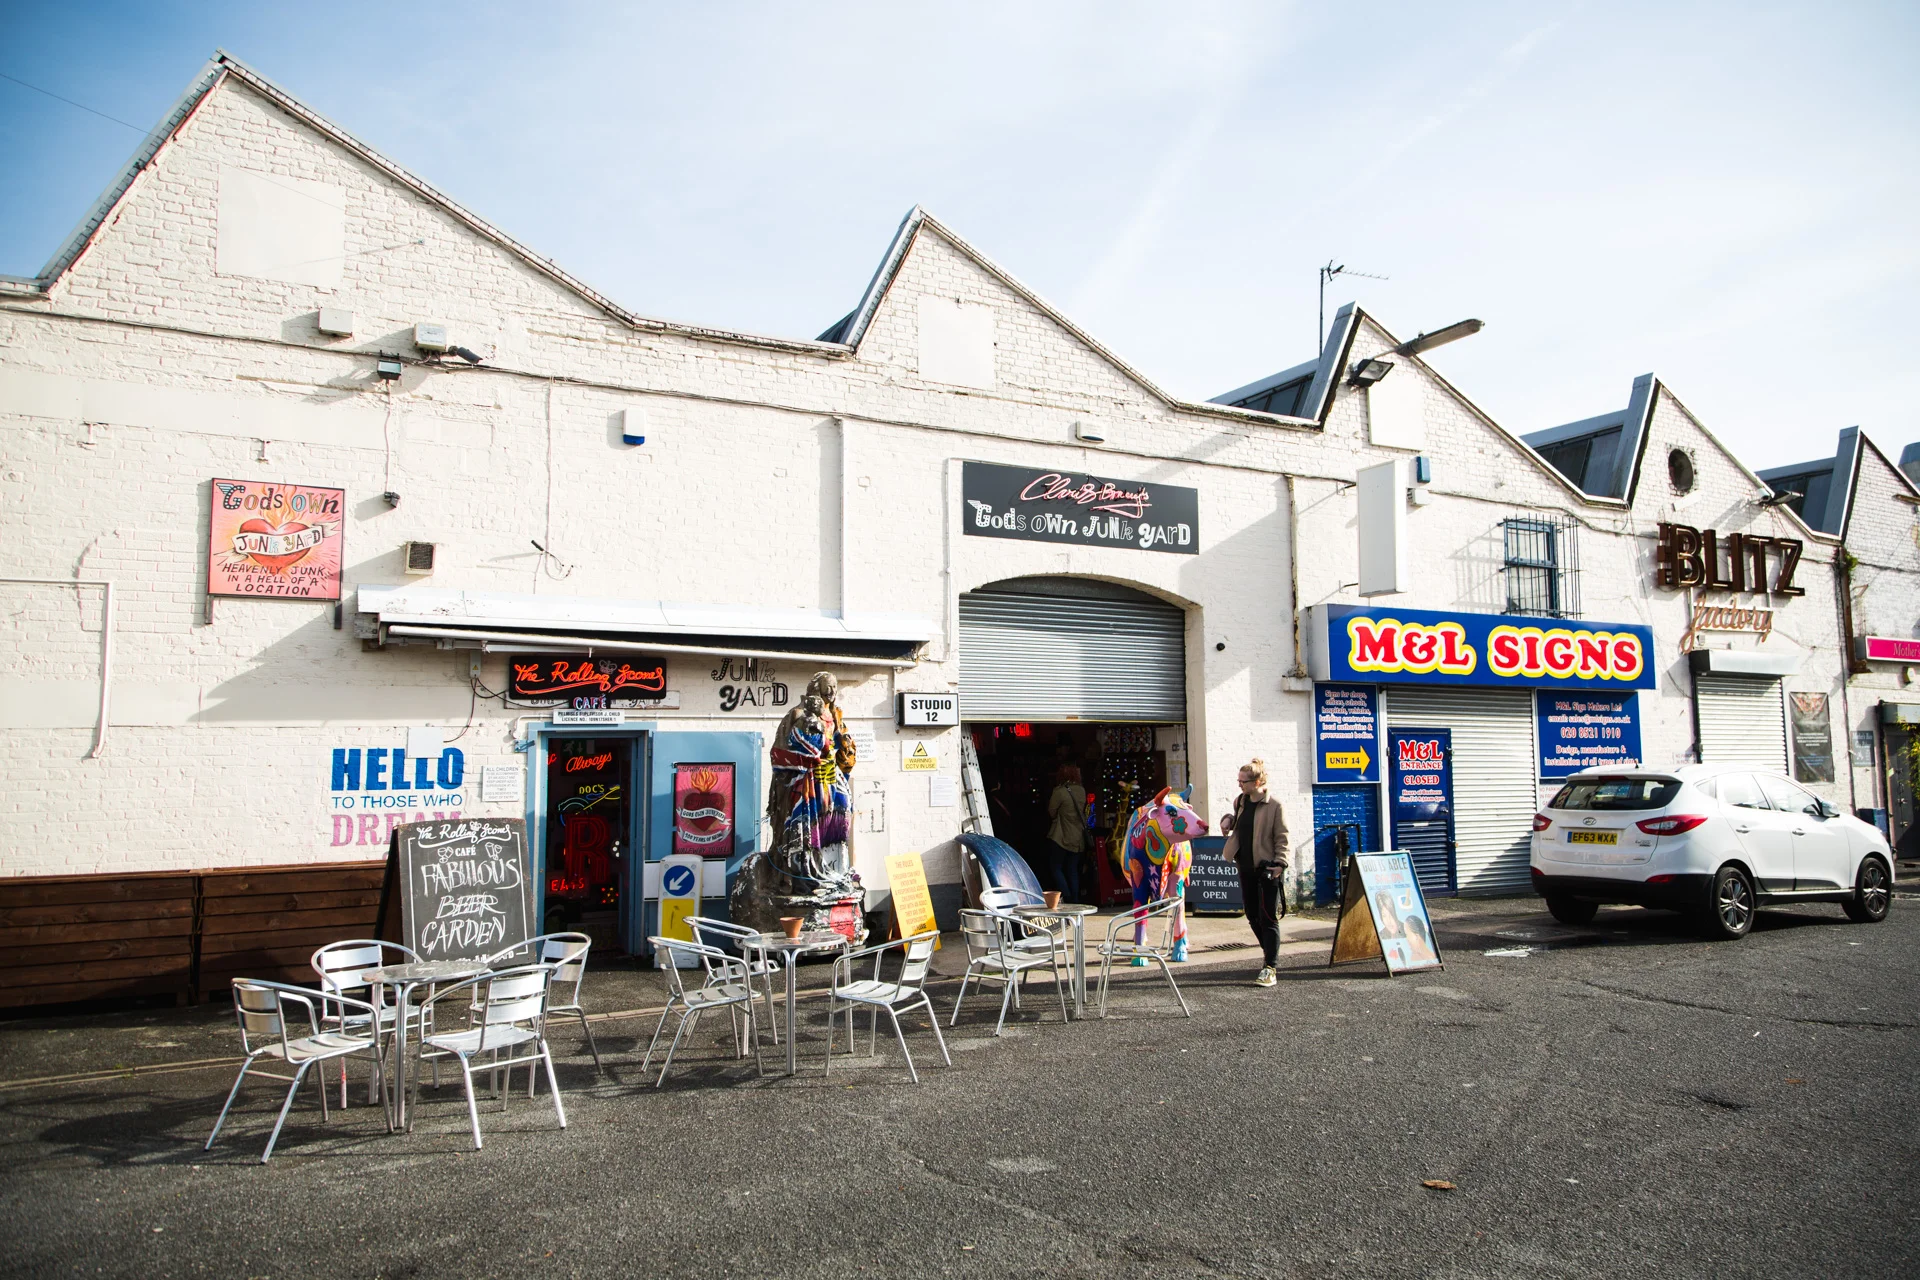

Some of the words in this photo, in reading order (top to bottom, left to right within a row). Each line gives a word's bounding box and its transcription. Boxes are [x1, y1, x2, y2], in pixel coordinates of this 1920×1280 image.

[216, 483, 283, 511] Gods
[967, 499, 1027, 532] Gods
[1657, 522, 1806, 597] BLITZ
[221, 563, 283, 575] HEAVENLY
[290, 566, 326, 577] JUNK
[227, 574, 239, 582] IN
[244, 574, 252, 582] A
[257, 575, 285, 584] HELL
[291, 576, 303, 585] OF
[309, 576, 319, 586] A
[235, 584, 311, 596] LOCATION
[1350, 621, 1474, 670] M&L
[1490, 630, 1641, 676] SIGNS
[573, 694, 608, 710] CAFÉ
[911, 700, 952, 710] STUDIO
[1573, 702, 1586, 713] Sign
[1587, 702, 1610, 711] Makers
[925, 712, 938, 722] 12
[1561, 727, 1577, 738] 020
[1601, 727, 1622, 739] 1910
[1398, 739, 1444, 761] M&L
[566, 751, 613, 772] Always
[1400, 761, 1443, 770] ENTRANCE
[331, 747, 464, 791] HELLO
[1404, 775, 1439, 785] CLOSED
[579, 784, 605, 794] DOC'S
[331, 796, 355, 809] TO
[360, 795, 418, 808] THOSE
[423, 794, 463, 807] WHO
[440, 823, 478, 844] Rolling
[1572, 832, 1595, 842] EF63
[455, 845, 476, 856] CAFÉ
[1190, 865, 1205, 875] ER
[1207, 866, 1239, 876] GARD
[1361, 859, 1377, 872] GOD
[1387, 857, 1408, 871] ABLE
[421, 859, 520, 897] FABULOUS
[1203, 891, 1227, 899] OPEN
[435, 892, 506, 919] BEER
[421, 915, 507, 955] GARDEN
